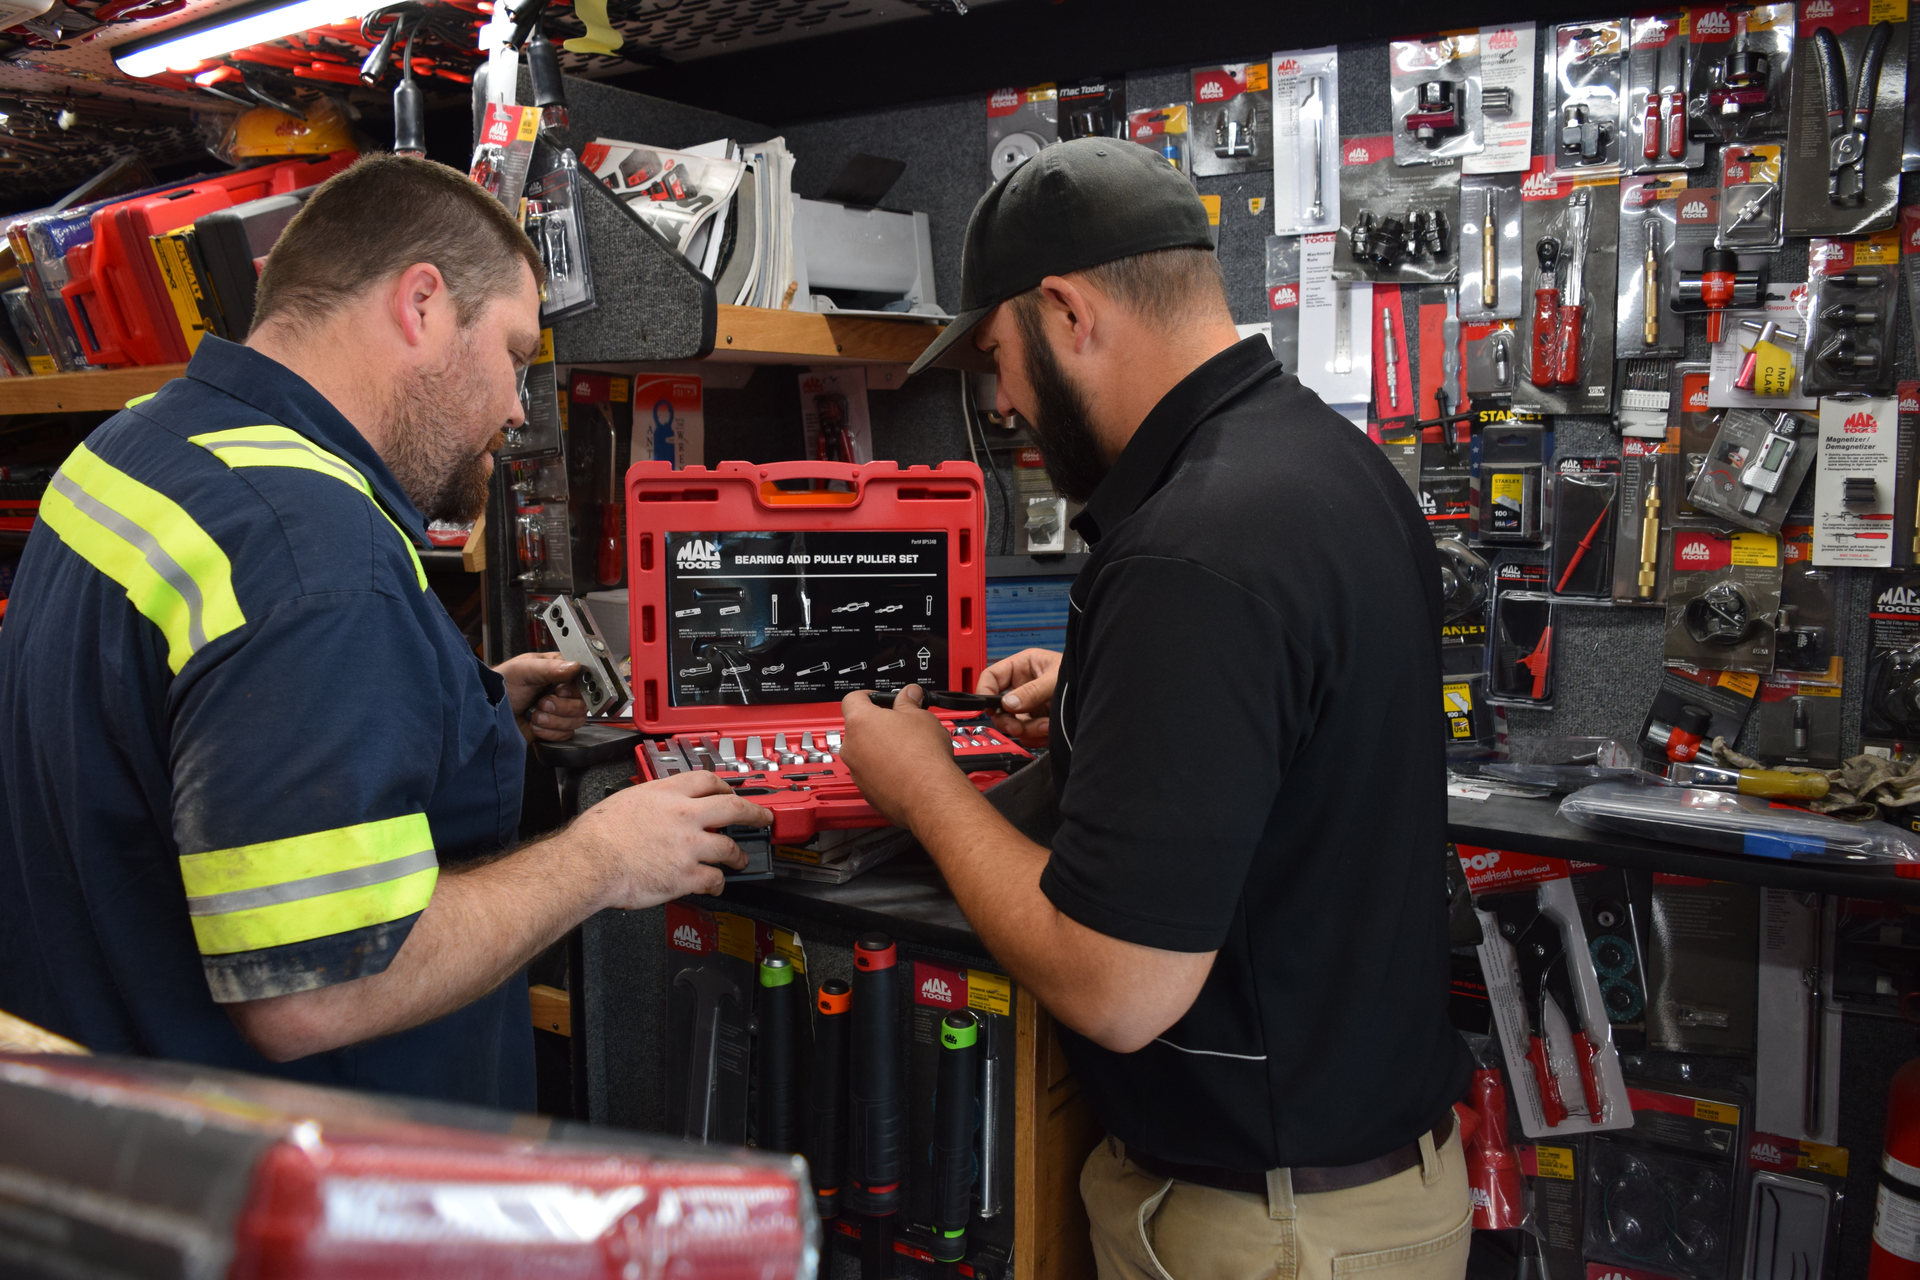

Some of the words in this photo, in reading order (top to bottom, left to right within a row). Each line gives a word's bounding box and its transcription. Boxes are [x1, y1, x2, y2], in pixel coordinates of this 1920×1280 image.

[1696, 12, 1731, 27] MAC
[1489, 29, 1517, 43] MAC
[1697, 26, 1731, 34] TOOLS
[1278, 59, 1301, 71] MAC
[1059, 88, 1079, 97] Mac
[1080, 84, 1105, 94] Tools
[1200, 81, 1223, 95] MAC
[992, 87, 1018, 102] MAC
[1200, 92, 1223, 100] TOOLS
[991, 100, 1018, 108] TOOLS
[489, 122, 508, 136] MAC
[488, 134, 507, 142] TOOLS
[1349, 148, 1369, 158] MAC
[1727, 166, 1744, 175] MAC
[1522, 189, 1558, 197] TOOLS
[1682, 201, 1708, 214] MAC
[175, 241, 204, 300] DEWALT
[1275, 288, 1296, 301] MAC
[1275, 297, 1296, 305] TOOLS
[575, 381, 591, 392] MAC
[803, 378, 823, 388] MAC
[1899, 399, 1919, 408] MAC
[1844, 412, 1877, 427] MAC
[1626, 442, 1643, 451] MAC
[1560, 459, 1581, 469] MAC
[676, 539, 721, 561] MAC
[1682, 542, 1710, 555] MAC
[676, 561, 721, 569] TOOLS
[735, 555, 783, 565] BEARING
[787, 555, 811, 564] AND
[814, 555, 854, 564] PULLEY
[856, 555, 896, 564] PULLER
[899, 554, 919, 563] SET
[1501, 565, 1521, 574] MAC
[1877, 586, 1920, 605] MAC
[1877, 605, 1920, 613] TOOLS
[1442, 625, 1486, 636] ANLEY
[1460, 851, 1500, 873] POP
[1467, 867, 1512, 886] wivelHead
[1513, 864, 1551, 877] Rivetool
[673, 925, 701, 945] MAC
[673, 939, 701, 951] TOOLS
[922, 978, 952, 996] MAC
[922, 991, 952, 1003] TOOLS
[1750, 1143, 1781, 1159] MAC
[1750, 1154, 1781, 1164] TOOLS
